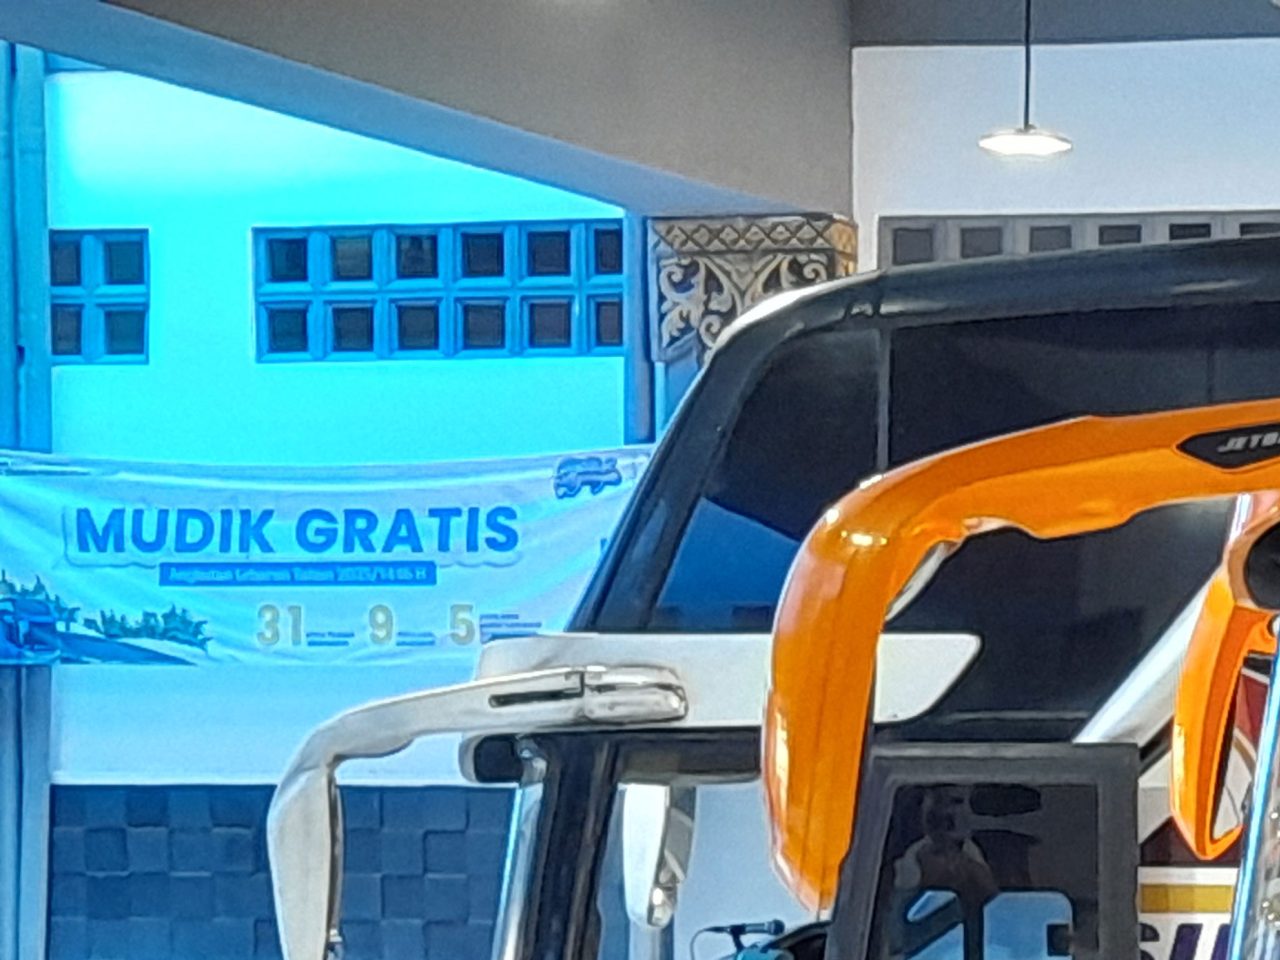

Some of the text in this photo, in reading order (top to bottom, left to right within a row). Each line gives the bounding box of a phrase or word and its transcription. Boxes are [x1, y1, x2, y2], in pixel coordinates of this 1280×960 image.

[76, 506, 520, 553] MUDIK GRATIS
[256, 604, 301, 646] 31
[368, 604, 394, 646] 9
[450, 604, 476, 646] 5
